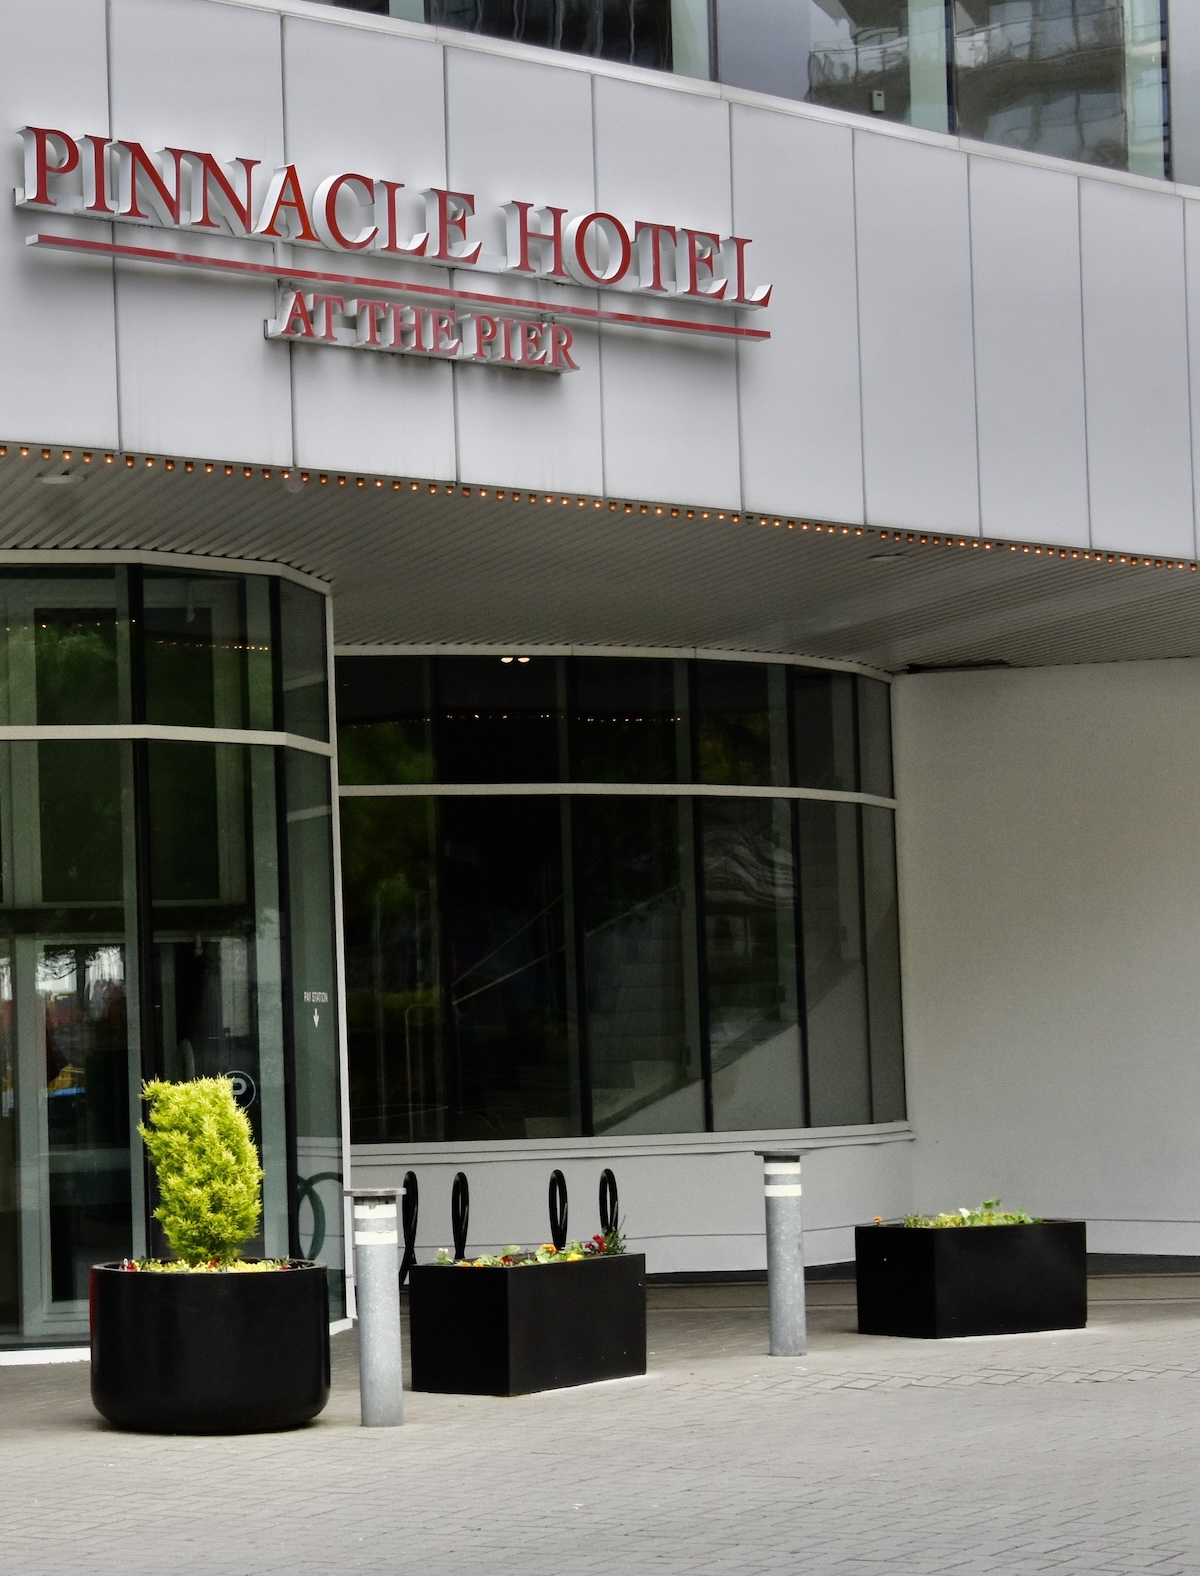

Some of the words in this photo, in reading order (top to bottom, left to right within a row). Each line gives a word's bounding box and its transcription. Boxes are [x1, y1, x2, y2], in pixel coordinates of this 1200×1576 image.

[16, 126, 482, 265] PINNACLE
[502, 200, 773, 308] HOTEL
[281, 289, 344, 341] AT
[349, 298, 461, 357] THE
[461, 313, 580, 370] PIER
[312, 991, 328, 1002] STATION
